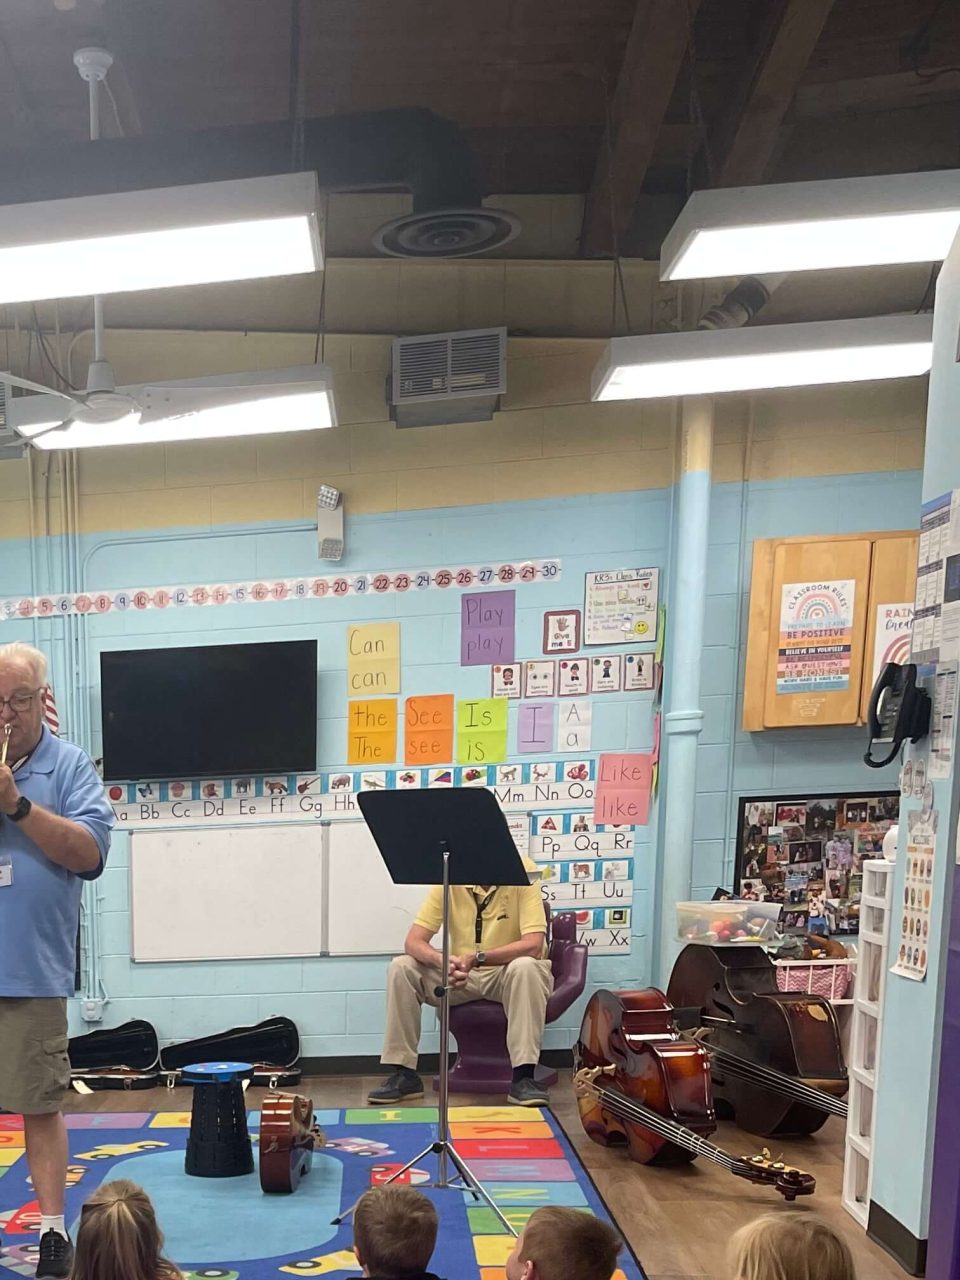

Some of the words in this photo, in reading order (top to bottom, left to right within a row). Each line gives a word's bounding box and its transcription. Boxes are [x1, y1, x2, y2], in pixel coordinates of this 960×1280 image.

[136, 595, 146, 606] 10
[175, 593, 185, 604] 12
[235, 589, 245, 599] 15
[275, 586, 284, 597] 17
[295, 585, 305, 595] 18
[315, 584, 325, 595] 19
[334, 581, 347, 593] 20
[357, 580, 366, 591] 21
[374, 578, 389, 590] 22
[396, 577, 409, 588] 23
[417, 575, 430, 587] 24
[437, 573, 451, 585] 25
[457, 572, 472, 583] 26
[479, 570, 493, 582] 27
[501, 569, 514, 580] 28
[543, 565, 557, 577] 30
[788, 584, 830, 610] CLASSROOM
[831, 587, 848, 608] RULES
[466, 598, 504, 626] Play
[350, 630, 386, 656] Can
[566, 639, 572, 647] 5
[787, 631, 798, 639] BE
[801, 629, 845, 638] POSITIVE
[466, 634, 505, 660] play
[785, 648, 807, 656] BELIEVE
[817, 646, 844, 654] YOURSELF
[351, 670, 387, 690] can
[354, 702, 388, 727] the
[408, 701, 442, 725] See
[465, 703, 492, 728] Is
[521, 706, 545, 743] I
[566, 704, 581, 723] A
[355, 736, 383, 758] The
[408, 740, 442, 755] see
[467, 741, 485, 761] is
[566, 733, 579, 747] a
[600, 756, 642, 785] Like
[140, 804, 160, 820] Bb
[171, 802, 191, 818] Cc
[203, 800, 224, 817] Dd
[239, 799, 256, 815] Ee
[270, 797, 285, 813] Ff
[299, 795, 323, 819] Gg
[334, 794, 356, 811] Hh
[494, 787, 524, 803] Mm
[535, 785, 559, 801] Nn
[568, 782, 594, 799] Oo
[601, 791, 639, 817] like
[542, 836, 561, 859] Pp
[574, 834, 602, 858] Qq
[614, 833, 633, 850] Rr
[540, 885, 556, 902] Ss
[573, 883, 586, 900] Tt
[603, 882, 624, 899] Uu
[609, 930, 629, 947] Xx
[378, 1110, 403, 1121] I
[491, 1188, 550, 1200] N
